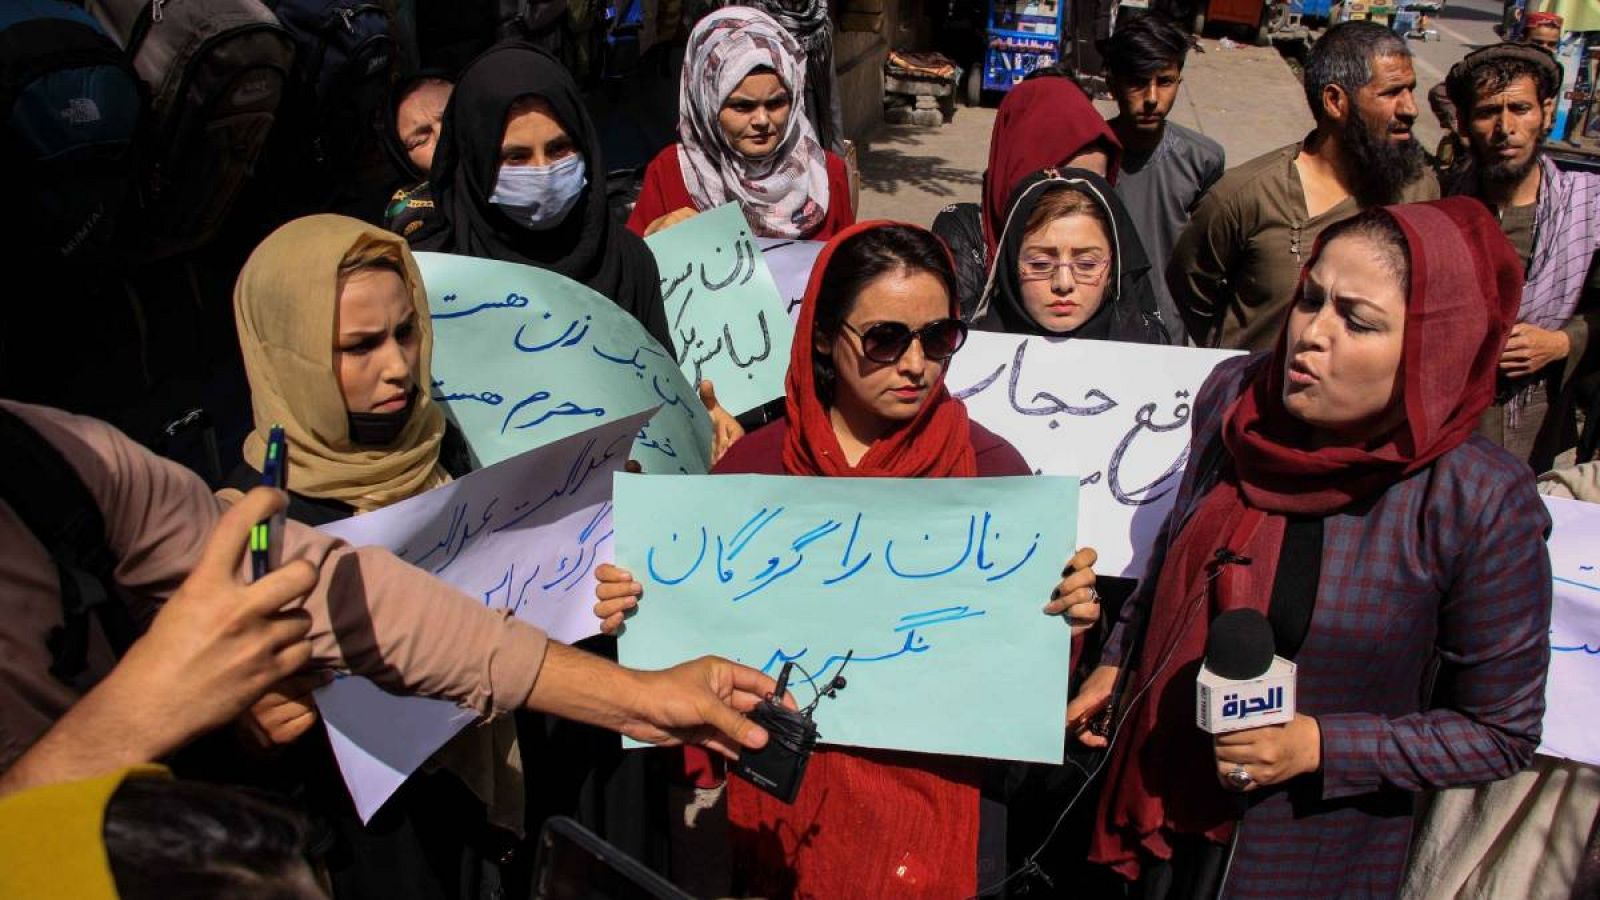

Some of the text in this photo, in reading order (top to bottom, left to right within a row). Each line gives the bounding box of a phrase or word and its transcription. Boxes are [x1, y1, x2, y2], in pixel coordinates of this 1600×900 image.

[513, 314, 592, 352] زن
[493, 434, 627, 534] عدالت
[823, 512, 872, 585] را
[885, 511, 1041, 583] زنان
[1222, 686, 1284, 719] الحرة
